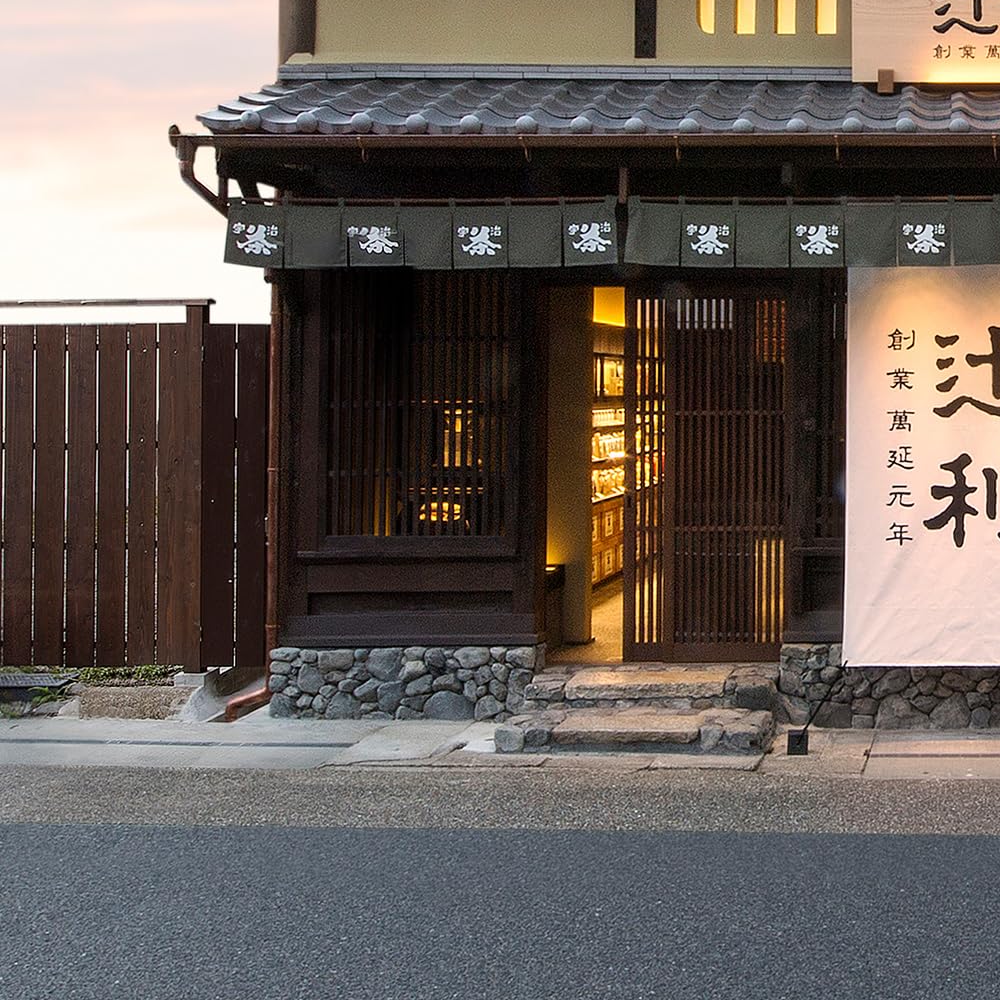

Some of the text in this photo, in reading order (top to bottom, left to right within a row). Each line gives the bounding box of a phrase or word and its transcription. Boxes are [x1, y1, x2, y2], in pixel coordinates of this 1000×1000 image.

[885, 328, 916, 546] 創業萬延元年
